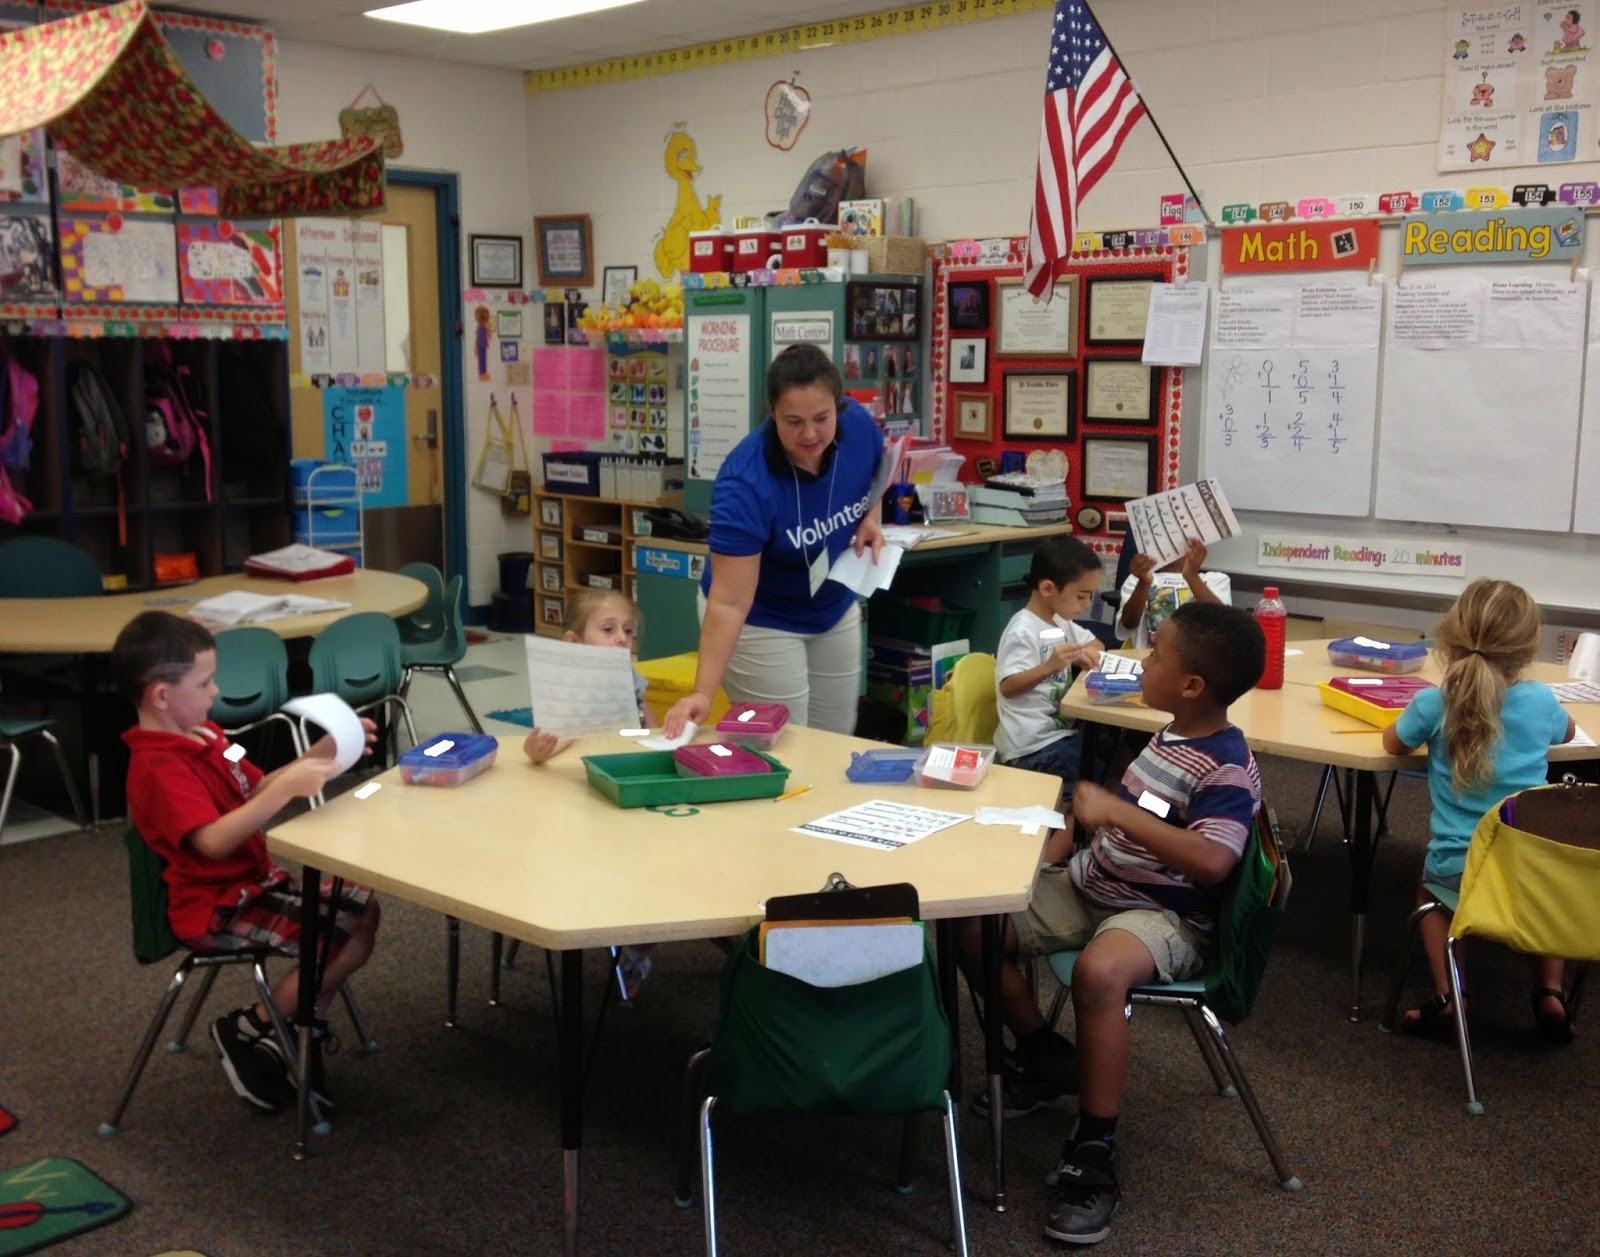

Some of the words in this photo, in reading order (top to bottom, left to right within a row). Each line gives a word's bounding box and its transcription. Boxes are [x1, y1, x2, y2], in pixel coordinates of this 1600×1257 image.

[780, 32, 790, 43] 20
[806, 27, 817, 38] 22
[823, 24, 833, 35] 23
[839, 22, 849, 33] 24
[855, 19, 865, 30] 25
[871, 16, 882, 28] 26
[888, 13, 898, 25] 27
[904, 10, 914, 22] 28
[921, 7, 932, 19] 29
[939, 4, 950, 16] 30
[958, 1, 967, 12] 31
[1480, 195, 1495, 203] 153
[1526, 192, 1543, 201] 154
[1574, 190, 1591, 199] 155
[1309, 205, 1323, 214] 149
[1350, 202, 1364, 210] 150
[1434, 199, 1449, 207] 152
[1164, 204, 1182, 220] flag
[1233, 210, 1246, 218] 147
[1404, 218, 1551, 259] Reading
[1239, 230, 1319, 264] Math
[701, 321, 737, 335] MORNING
[777, 326, 796, 338] Math
[797, 326, 826, 338] Centers
[699, 338, 739, 352] PROCEDURE
[1198, 482, 1211, 499] Let's
[646, 550, 679, 571] telephone
[1262, 541, 1330, 561] Independent
[1333, 545, 1386, 567] Reading:
[1393, 551, 1410, 563] 20
[1416, 551, 1462, 566] minutes
